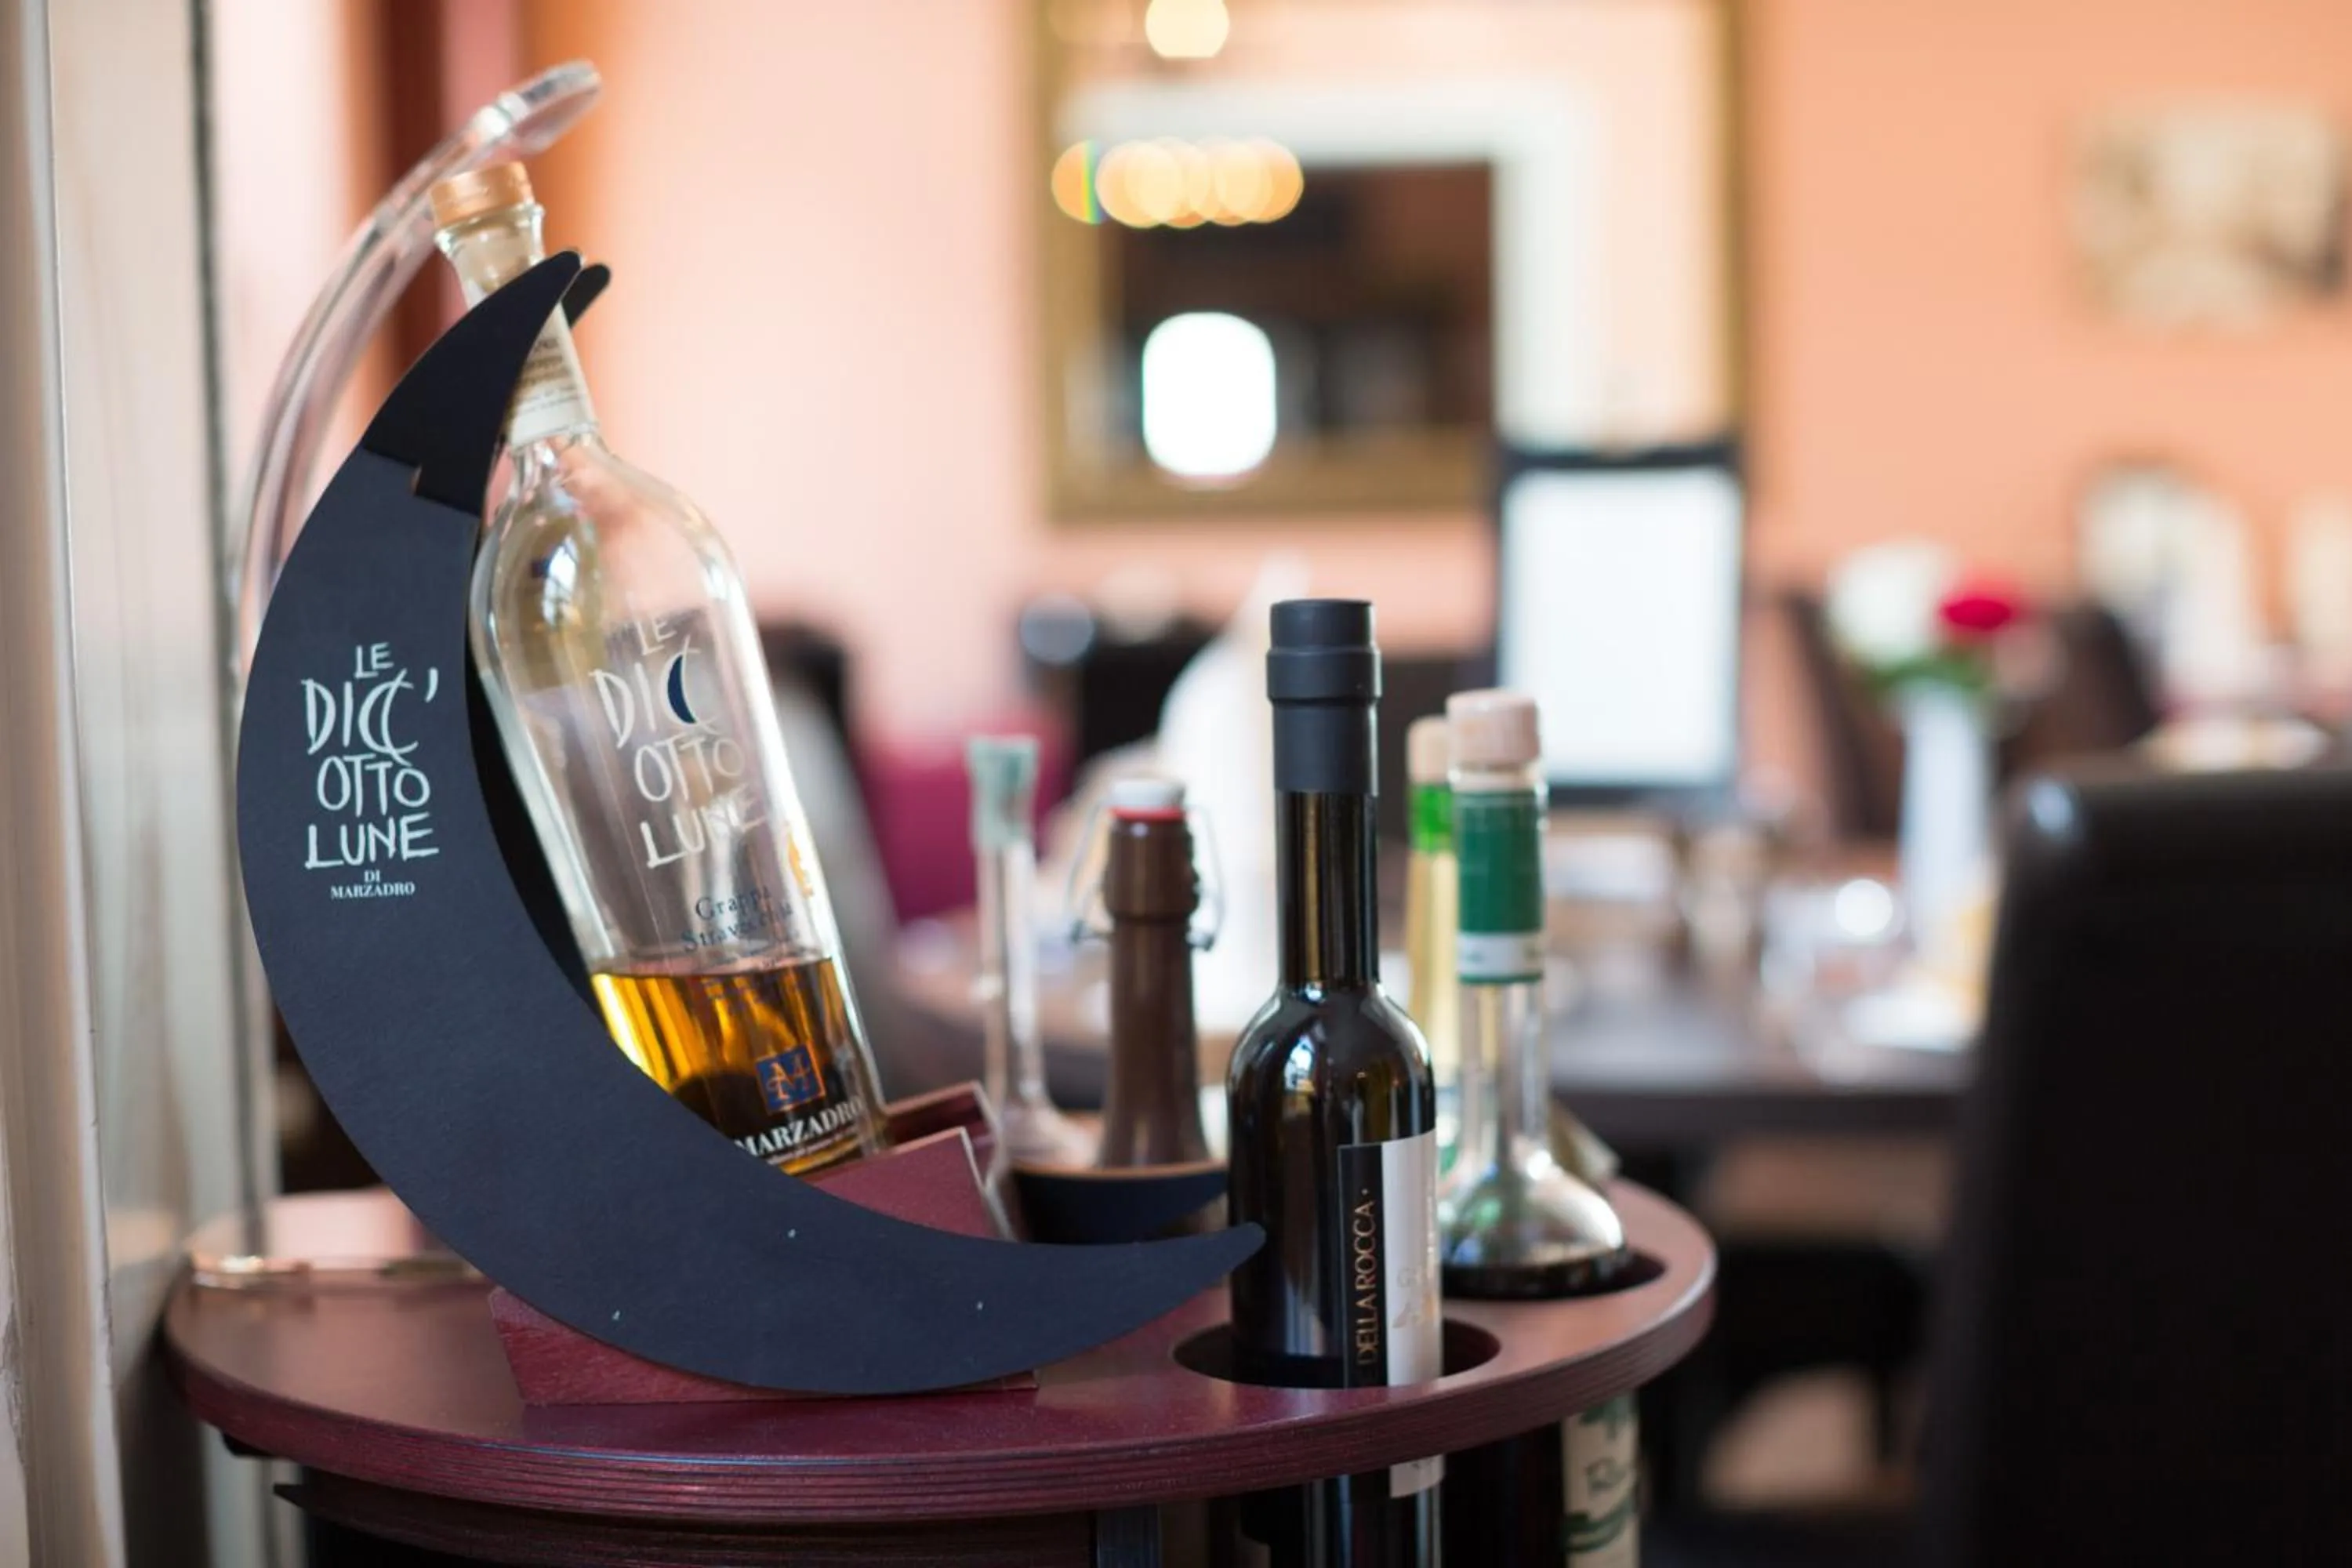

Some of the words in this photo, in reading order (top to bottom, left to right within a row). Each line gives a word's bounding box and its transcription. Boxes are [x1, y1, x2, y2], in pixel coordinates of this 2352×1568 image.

[354, 642, 394, 679] LE
[634, 616, 677, 655] LE
[317, 753, 431, 818] OTTO
[635, 732, 745, 803] OTTO
[304, 811, 440, 869] LUNE
[640, 783, 768, 869] LUNE
[330, 881, 416, 899] MARZADRO
[364, 869, 381, 884] DI
[734, 1097, 864, 1156] MARZADRO
[1352, 1200, 1377, 1290] ROCCA
[1356, 1294, 1379, 1365] DELLA
